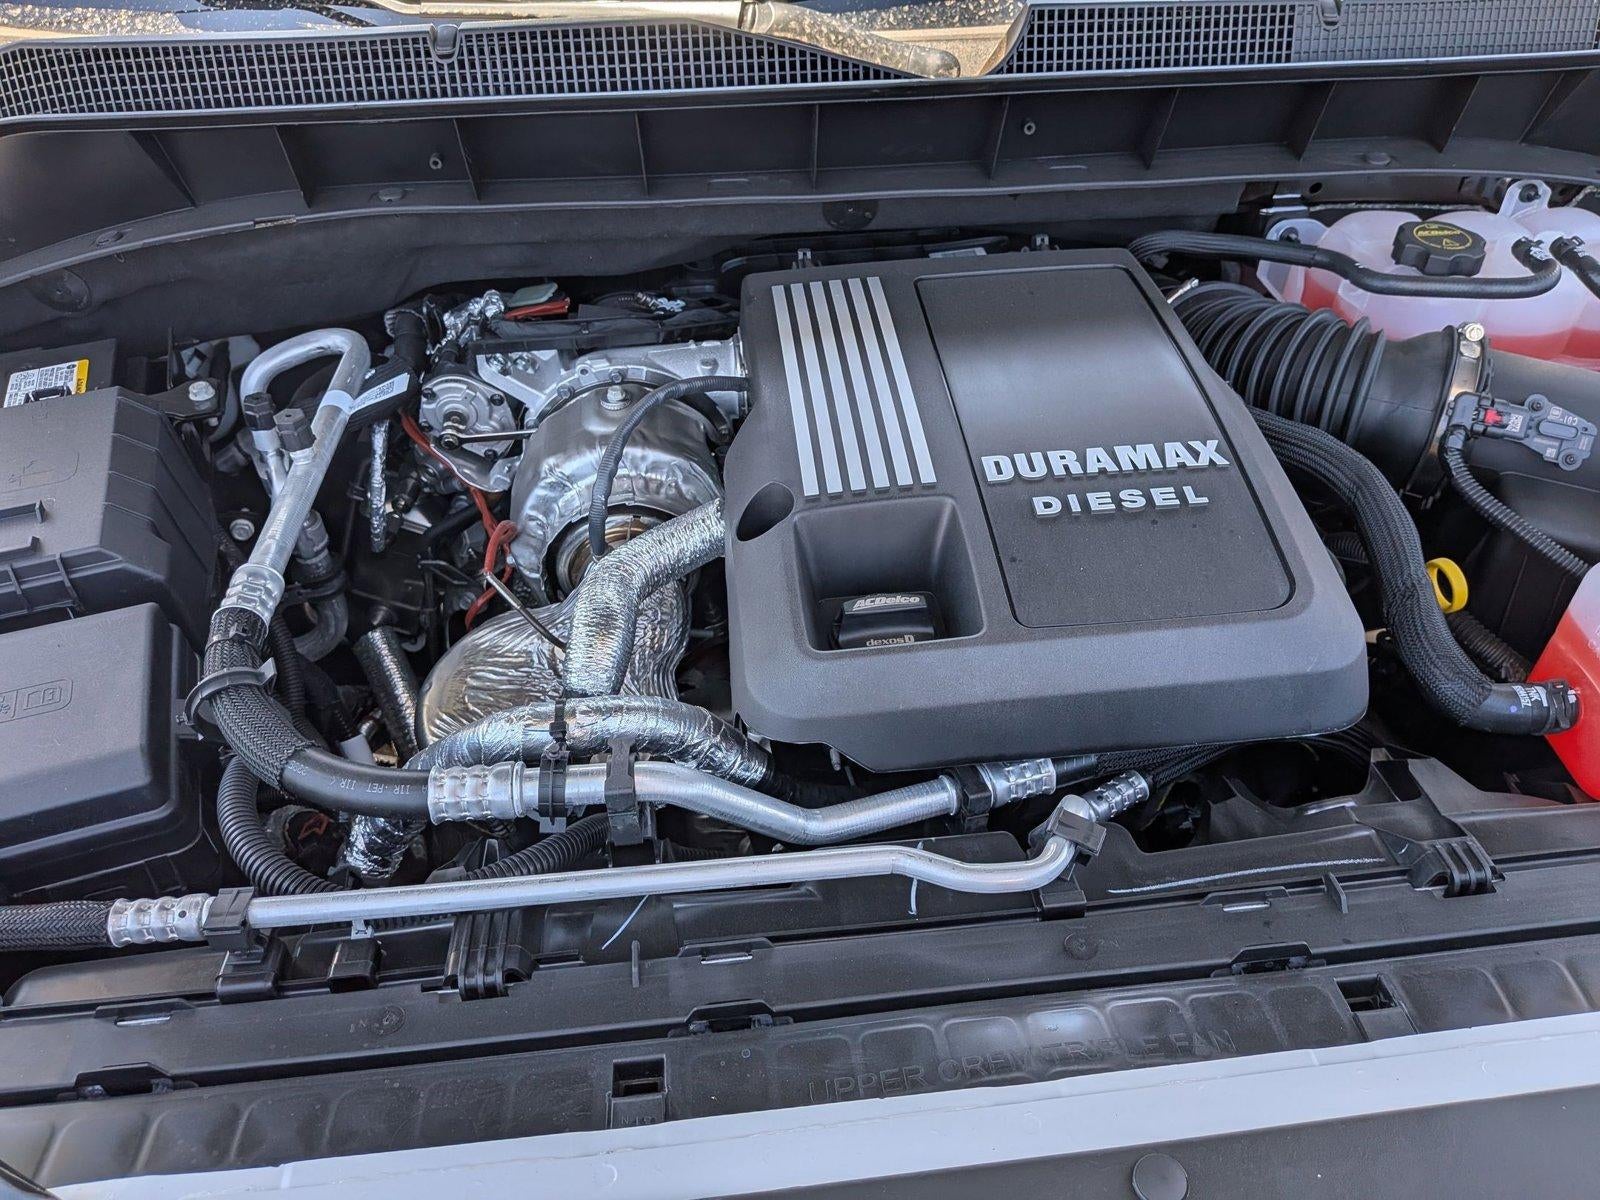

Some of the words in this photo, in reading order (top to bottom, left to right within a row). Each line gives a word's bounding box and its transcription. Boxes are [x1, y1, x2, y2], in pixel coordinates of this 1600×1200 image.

[980, 440, 1230, 483] DURAMAX
[1032, 485, 1210, 517] DIESEL
[852, 595, 921, 611] ACDelco
[808, 1064, 929, 1103] UPPER
[1170, 1029, 1238, 1057] FAN
